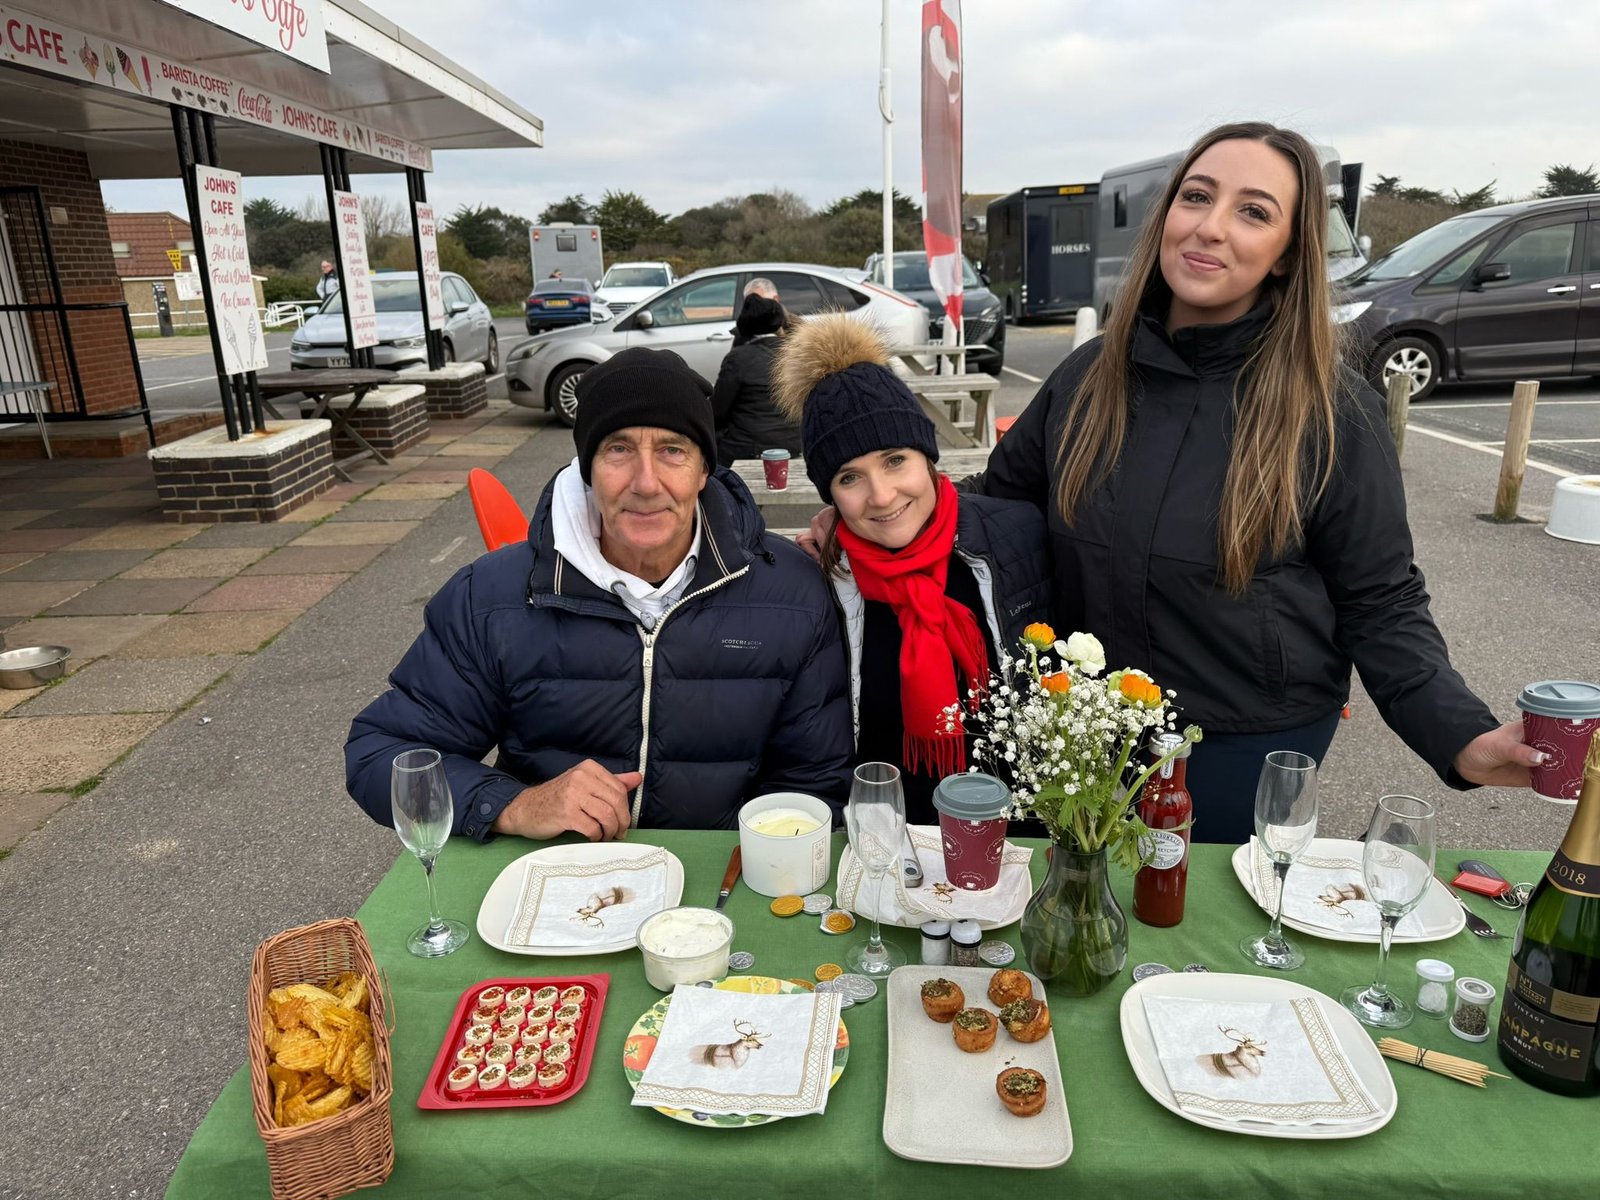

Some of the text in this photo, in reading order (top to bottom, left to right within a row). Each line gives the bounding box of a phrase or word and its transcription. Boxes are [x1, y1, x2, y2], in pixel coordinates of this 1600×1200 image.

[7, 19, 68, 65] CAFE
[161, 62, 230, 97] BARISTA COFFEE
[282, 104, 339, 140] JOHN'S CAFE
[204, 177, 236, 194] JOHN'S
[211, 200, 233, 215] CAFE
[343, 213, 357, 225] CAFE
[204, 220, 218, 237] Open
[421, 224, 434, 236] CAFE
[212, 243, 225, 262] Hot
[232, 245, 245, 262] Cold
[1051, 243, 1091, 254] HORSES
[212, 267, 229, 285] Food
[1552, 860, 1586, 885] 2018
[1513, 1001, 1545, 1024] VINTAGE
[1513, 1035, 1532, 1051] BRUT
